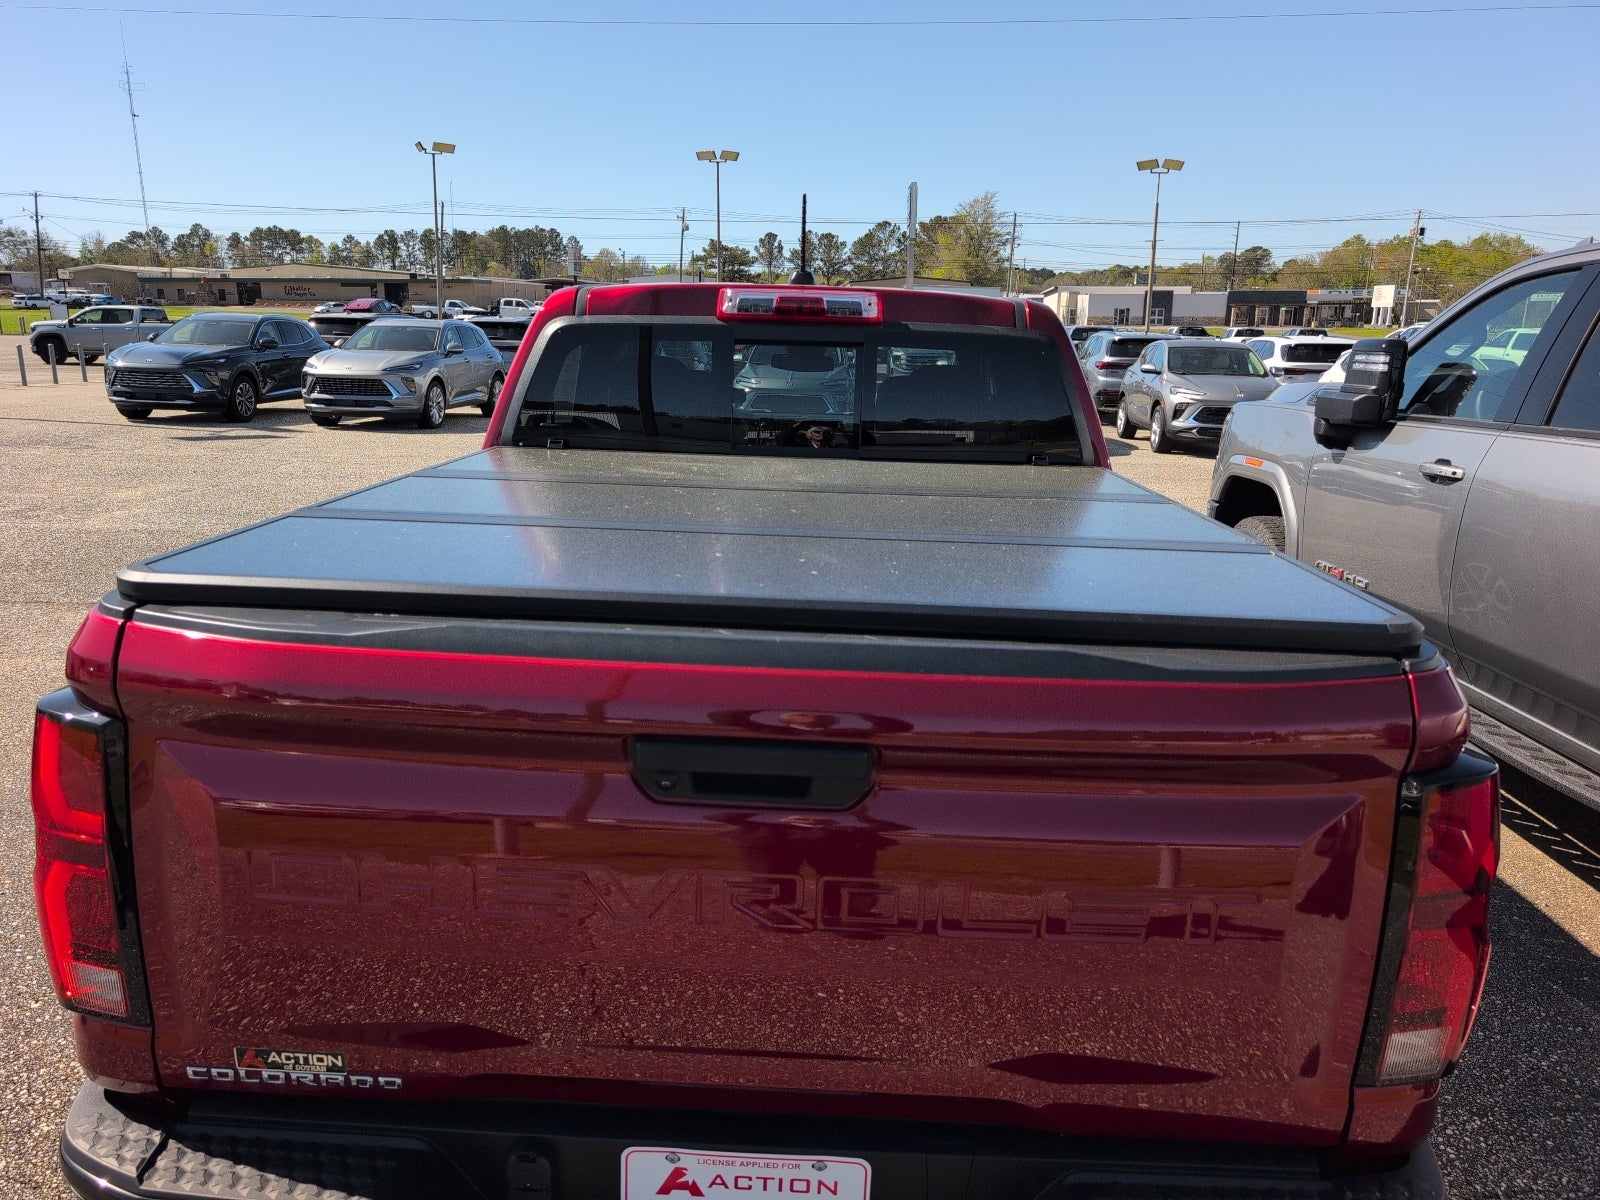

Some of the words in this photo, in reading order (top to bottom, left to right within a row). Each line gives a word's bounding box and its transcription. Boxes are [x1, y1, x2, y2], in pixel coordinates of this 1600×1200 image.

[246, 846, 1262, 946] CHEVROLET
[266, 1051, 343, 1067] ACTION
[186, 1066, 403, 1090] COLORADO
[697, 1158, 737, 1167] LICENSE
[739, 1161, 779, 1170] APPLIED
[707, 1174, 839, 1197] ACTION
